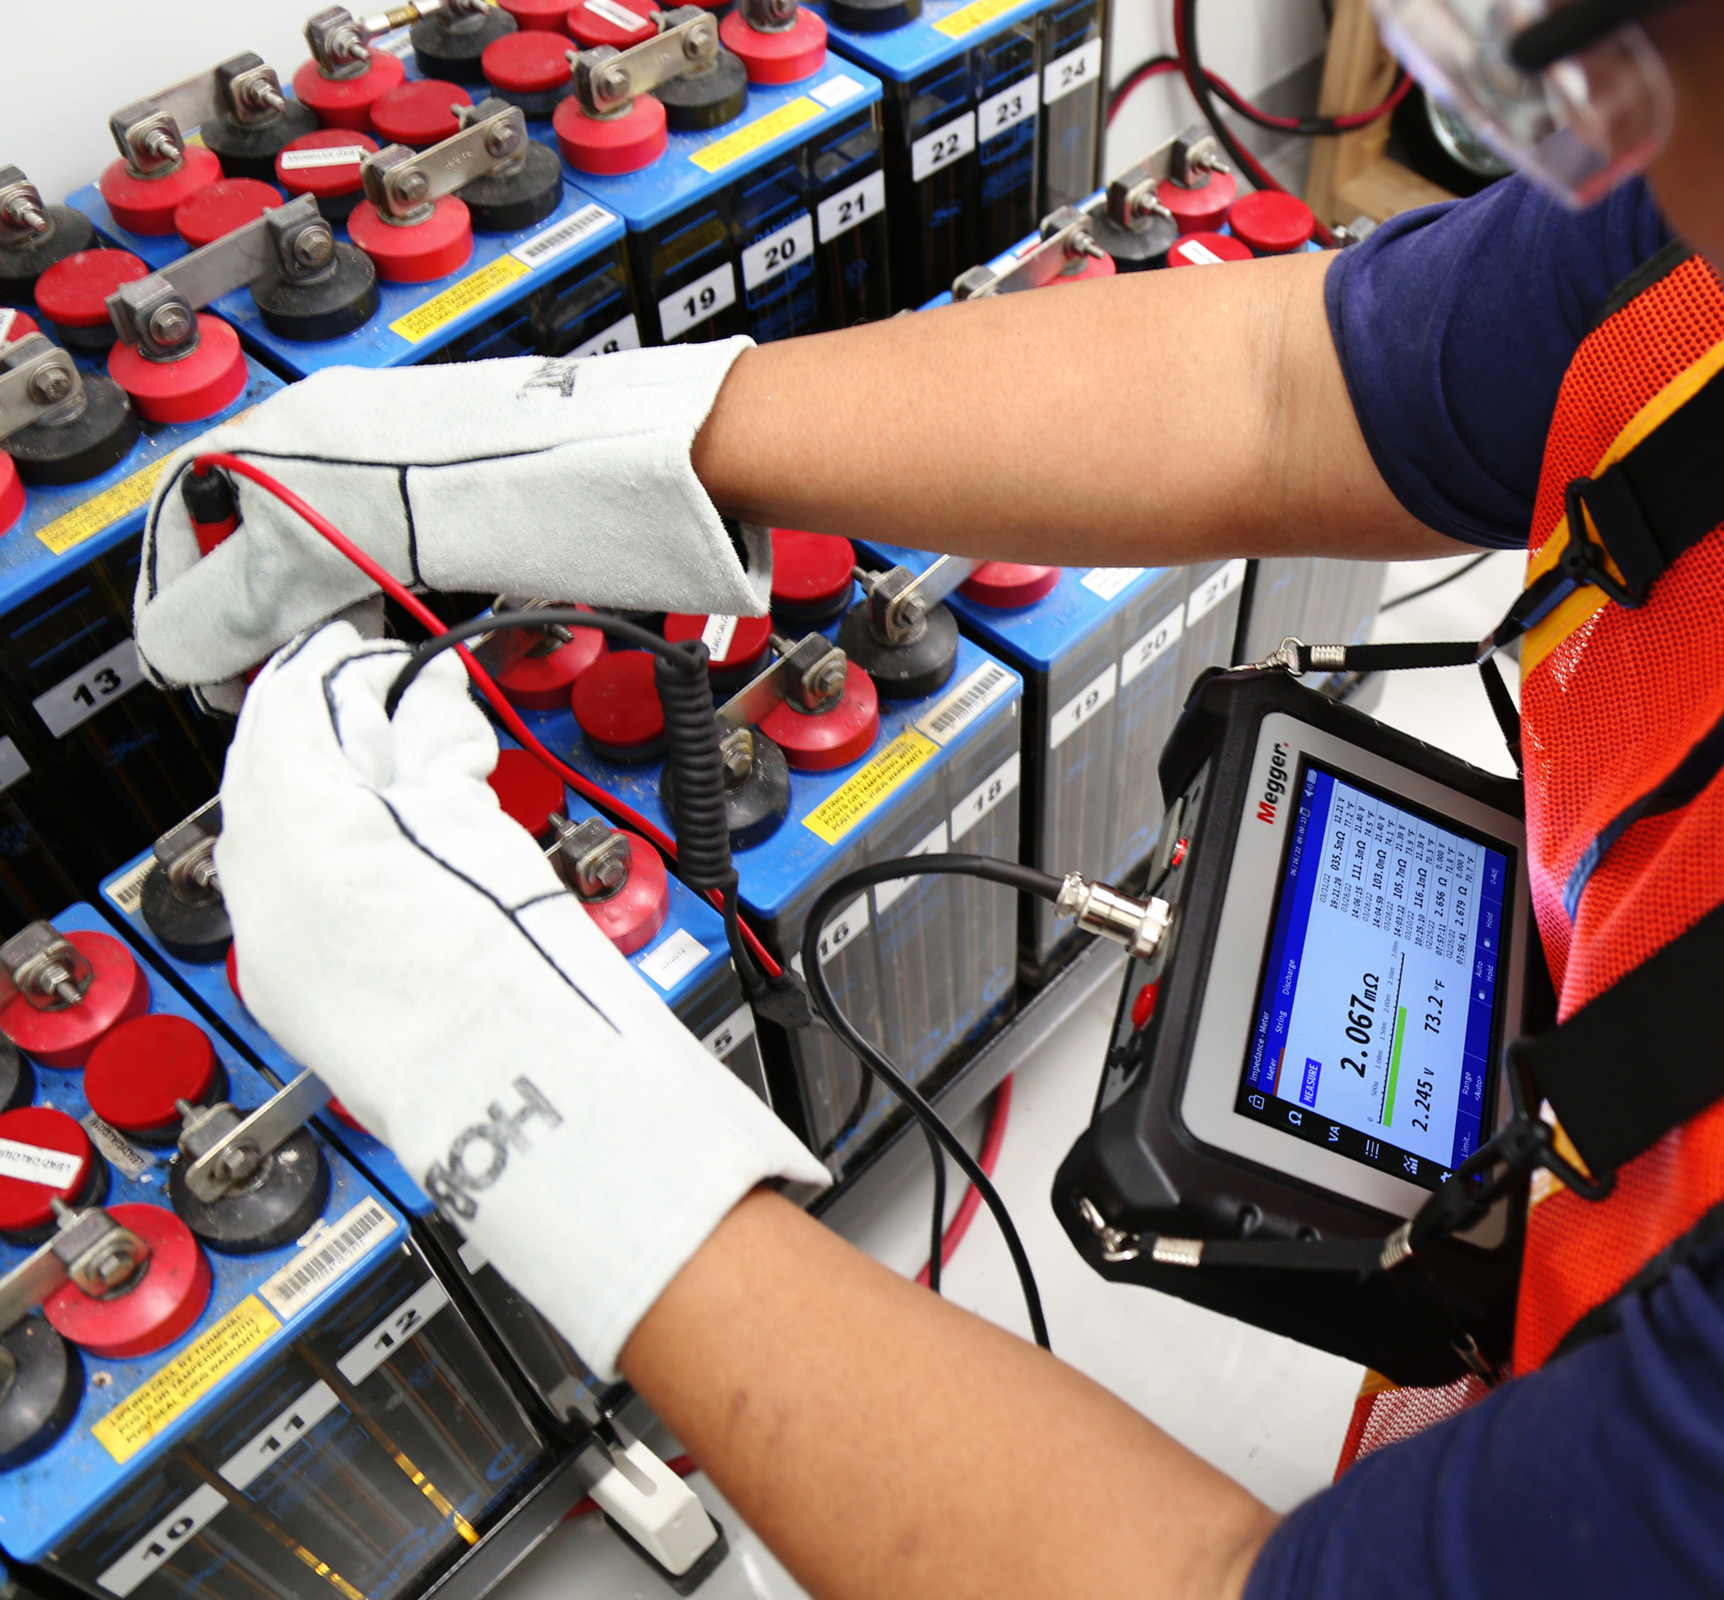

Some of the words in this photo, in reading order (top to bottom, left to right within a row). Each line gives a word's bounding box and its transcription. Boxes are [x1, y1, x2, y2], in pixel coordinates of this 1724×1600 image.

[1062, 57, 1086, 87] 24
[997, 95, 1022, 126] 23
[931, 132, 959, 164] 22
[838, 192, 866, 225] 21
[763, 237, 796, 271] 20
[683, 287, 716, 317] 19
[1204, 573, 1230, 605] 21
[1139, 629, 1167, 661] 20
[72, 668, 122, 708] 13
[1070, 688, 1099, 721] 19
[972, 779, 1002, 812] 18
[1333, 804, 1343, 823] 12.21
[1343, 812, 1353, 827] 77.2
[1354, 813, 1363, 833] 21.40
[1364, 821, 1373, 837] 74.5
[1374, 822, 1384, 842] 21.40
[1384, 830, 1394, 846] 74.1
[1394, 831, 1404, 851] 21.39
[1404, 839, 1413, 855] 73.9
[1415, 840, 1424, 861] 21.39
[1425, 848, 1433, 864] 70.3
[1435, 849, 1444, 869] 0.000
[1445, 857, 1453, 873] 71.8
[1455, 858, 1464, 878] 0.000
[1465, 866, 1473, 882] 70.7
[1319, 872, 1331, 903] 03/31/22
[1329, 876, 1341, 909] 19:21:28
[1340, 882, 1352, 912] 03/28/22
[1351, 885, 1363, 918] 14:06:15
[1361, 891, 1372, 922] 03/28/22
[1372, 895, 1383, 927] 14:04:59
[1382, 900, 1393, 931] 03/28/22
[1433, 890, 1445, 917] 2.656
[1454, 899, 1465, 926] 2.679
[1393, 904, 1405, 937] 14:03:22
[1403, 910, 1414, 940] 03/10/22
[1414, 913, 1425, 946] 10:25:10
[1424, 919, 1435, 949] 02/25/22
[1485, 911, 1493, 928] Hold
[819, 920, 849, 955] 16
[1435, 923, 1446, 955] 07:57:11
[1445, 928, 1455, 959] 02/25/22
[1456, 932, 1466, 964] 07:56:41
[1475, 960, 1483, 978] Auto
[1485, 964, 1493, 982] Hold
[1382, 993, 1391, 1013] 2.00m
[1424, 995, 1443, 1033] 73.2
[1266, 1057, 1276, 1080] Meter
[1274, 1010, 1287, 1033] String
[1281, 958, 1296, 995] Discharge
[1249, 1038, 1264, 1081] Impedance
[1258, 1011, 1269, 1033] Meter
[1303, 1063, 1318, 1102] MEASURE
[1461, 1071, 1472, 1095] Range
[1473, 1075, 1482, 1100] <Auto>
[1411, 1078, 1432, 1132] 2.245
[1328, 1125, 1340, 1141] VA
[373, 1308, 422, 1350] 12
[259, 1414, 305, 1455] 11
[141, 1516, 194, 1559] 10
